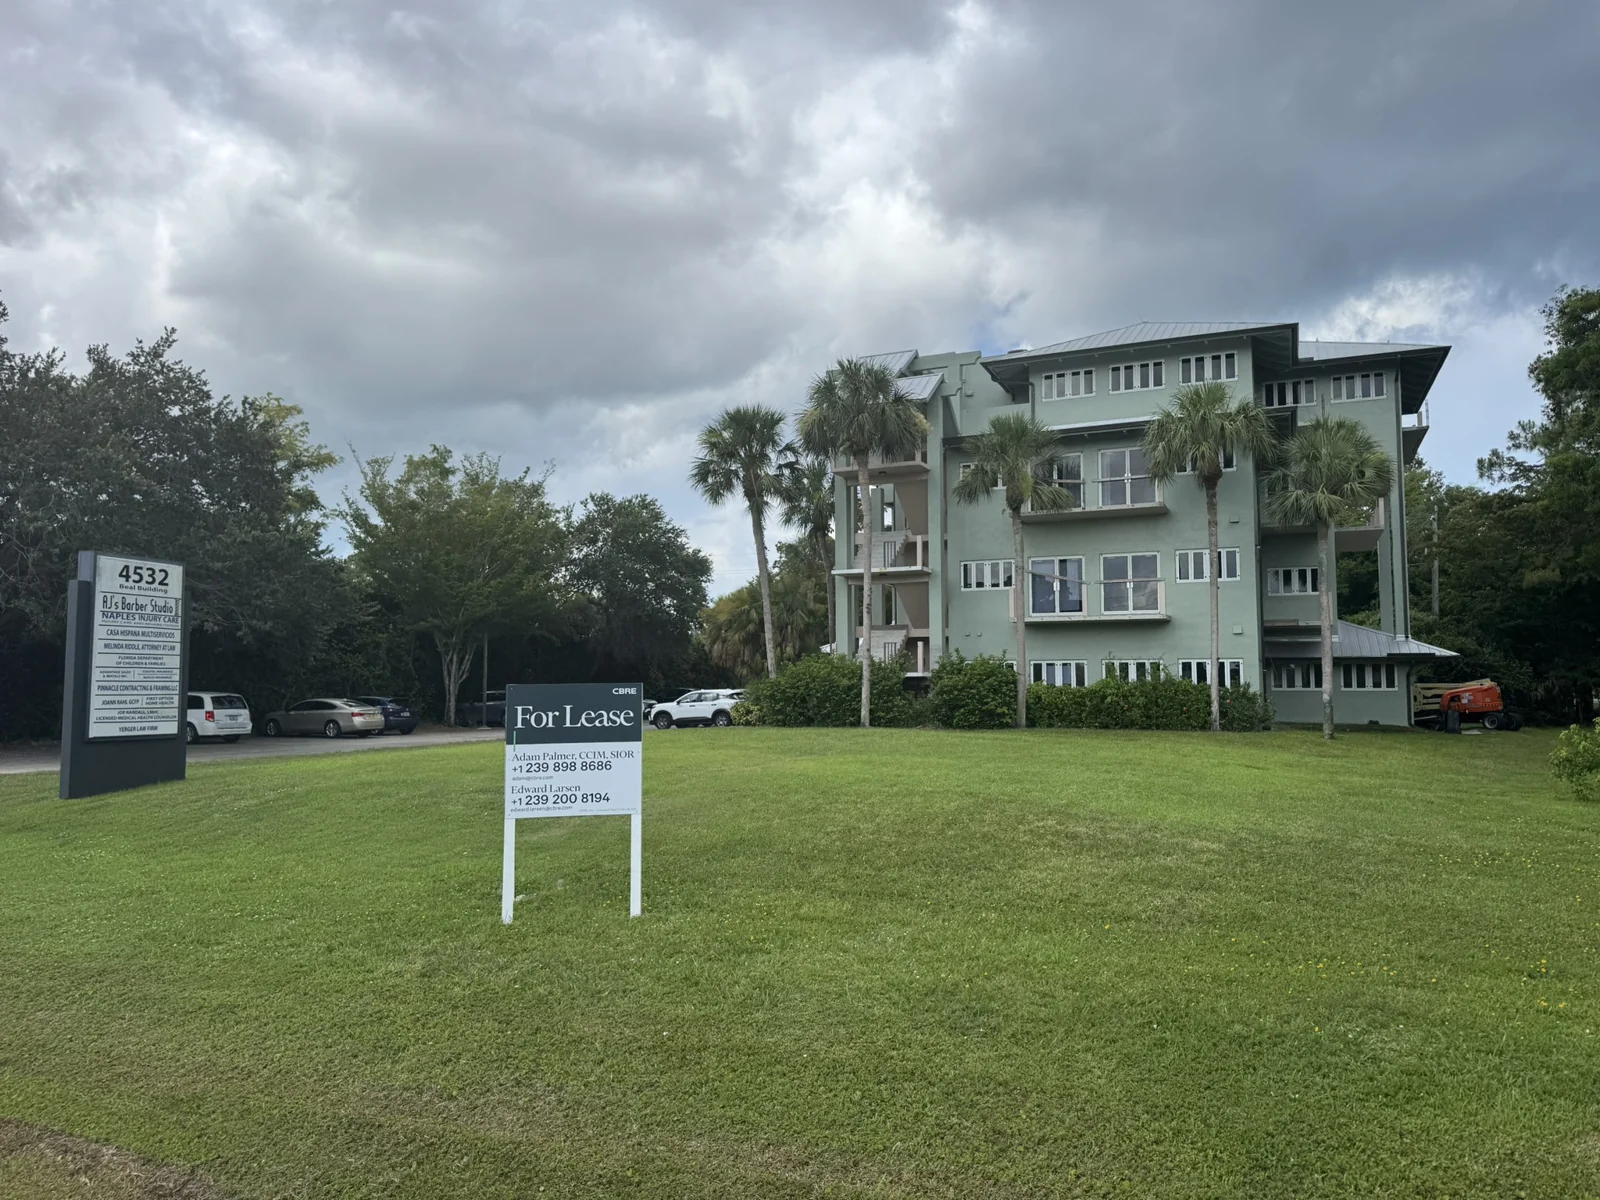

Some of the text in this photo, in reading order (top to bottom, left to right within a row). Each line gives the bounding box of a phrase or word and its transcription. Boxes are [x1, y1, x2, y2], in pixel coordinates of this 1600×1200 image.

[118, 564, 169, 586] 4532
[138, 586, 168, 594] Building
[102, 594, 174, 614] AJ's Barber Studio
[102, 612, 136, 620] NAPLES
[138, 614, 163, 622] INJURY
[141, 630, 175, 638] MULTISERVICIOS
[514, 704, 634, 728] For Lease
[512, 750, 634, 762] Adam Palmer, CCIM, SIOR
[526, 762, 549, 773] 239
[553, 762, 577, 772] 898
[580, 761, 612, 771] 8686
[511, 784, 581, 794] Edward Larsen
[525, 794, 549, 805] 239
[552, 794, 577, 804] 200
[581, 792, 610, 803] 8194
